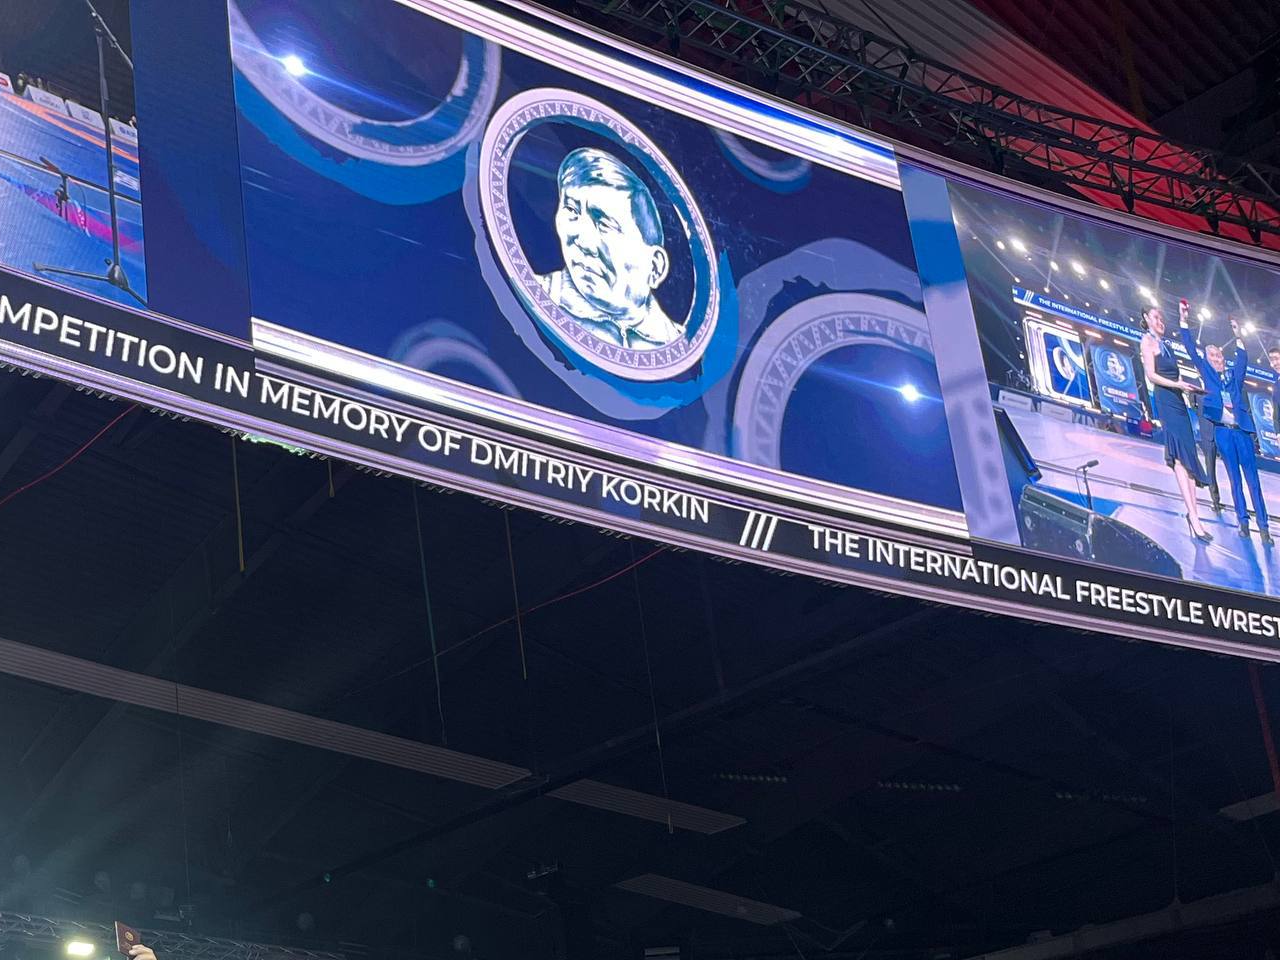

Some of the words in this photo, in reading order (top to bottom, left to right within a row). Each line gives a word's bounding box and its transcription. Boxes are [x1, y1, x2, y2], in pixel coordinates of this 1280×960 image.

[214, 361, 250, 399] IN
[259, 376, 411, 443] MEMORY
[418, 424, 462, 456] OF
[470, 432, 595, 493] DMITRIY
[601, 473, 710, 523] KORKIN
[808, 524, 860, 559] THE
[867, 537, 1071, 601] INTERNATIONAL
[1076, 580, 1204, 625] FREESTYLE
